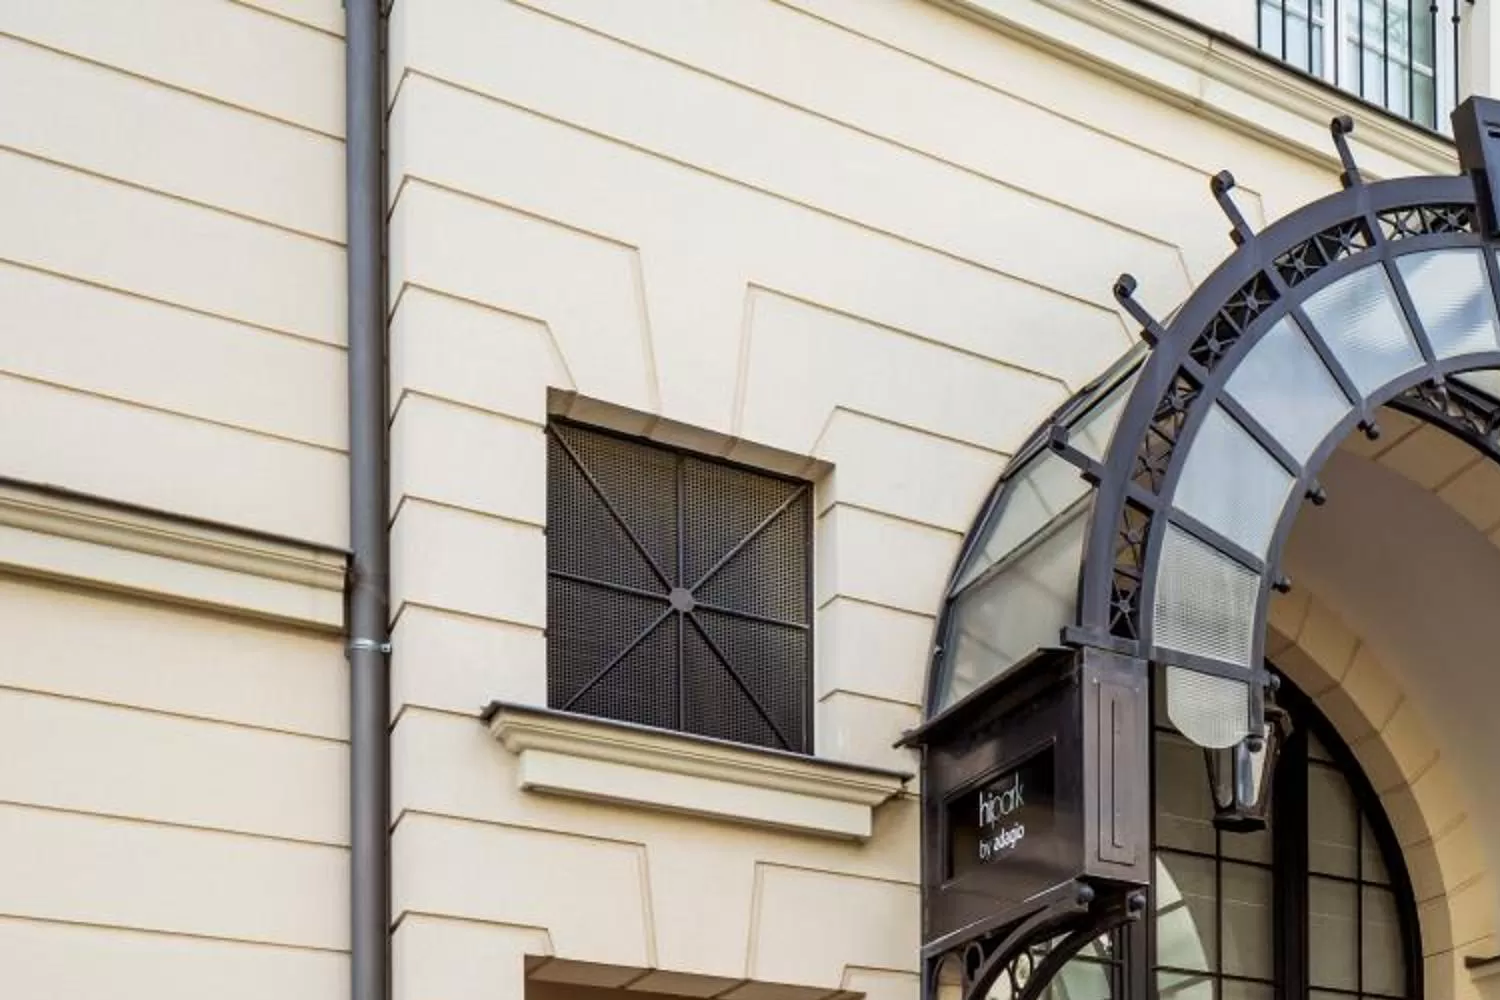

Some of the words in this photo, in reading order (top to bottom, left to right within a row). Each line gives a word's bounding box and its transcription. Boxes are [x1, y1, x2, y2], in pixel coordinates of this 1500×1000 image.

[979, 771, 1025, 830] hipark
[979, 838, 991, 861] by
[993, 821, 1025, 851] adagio
